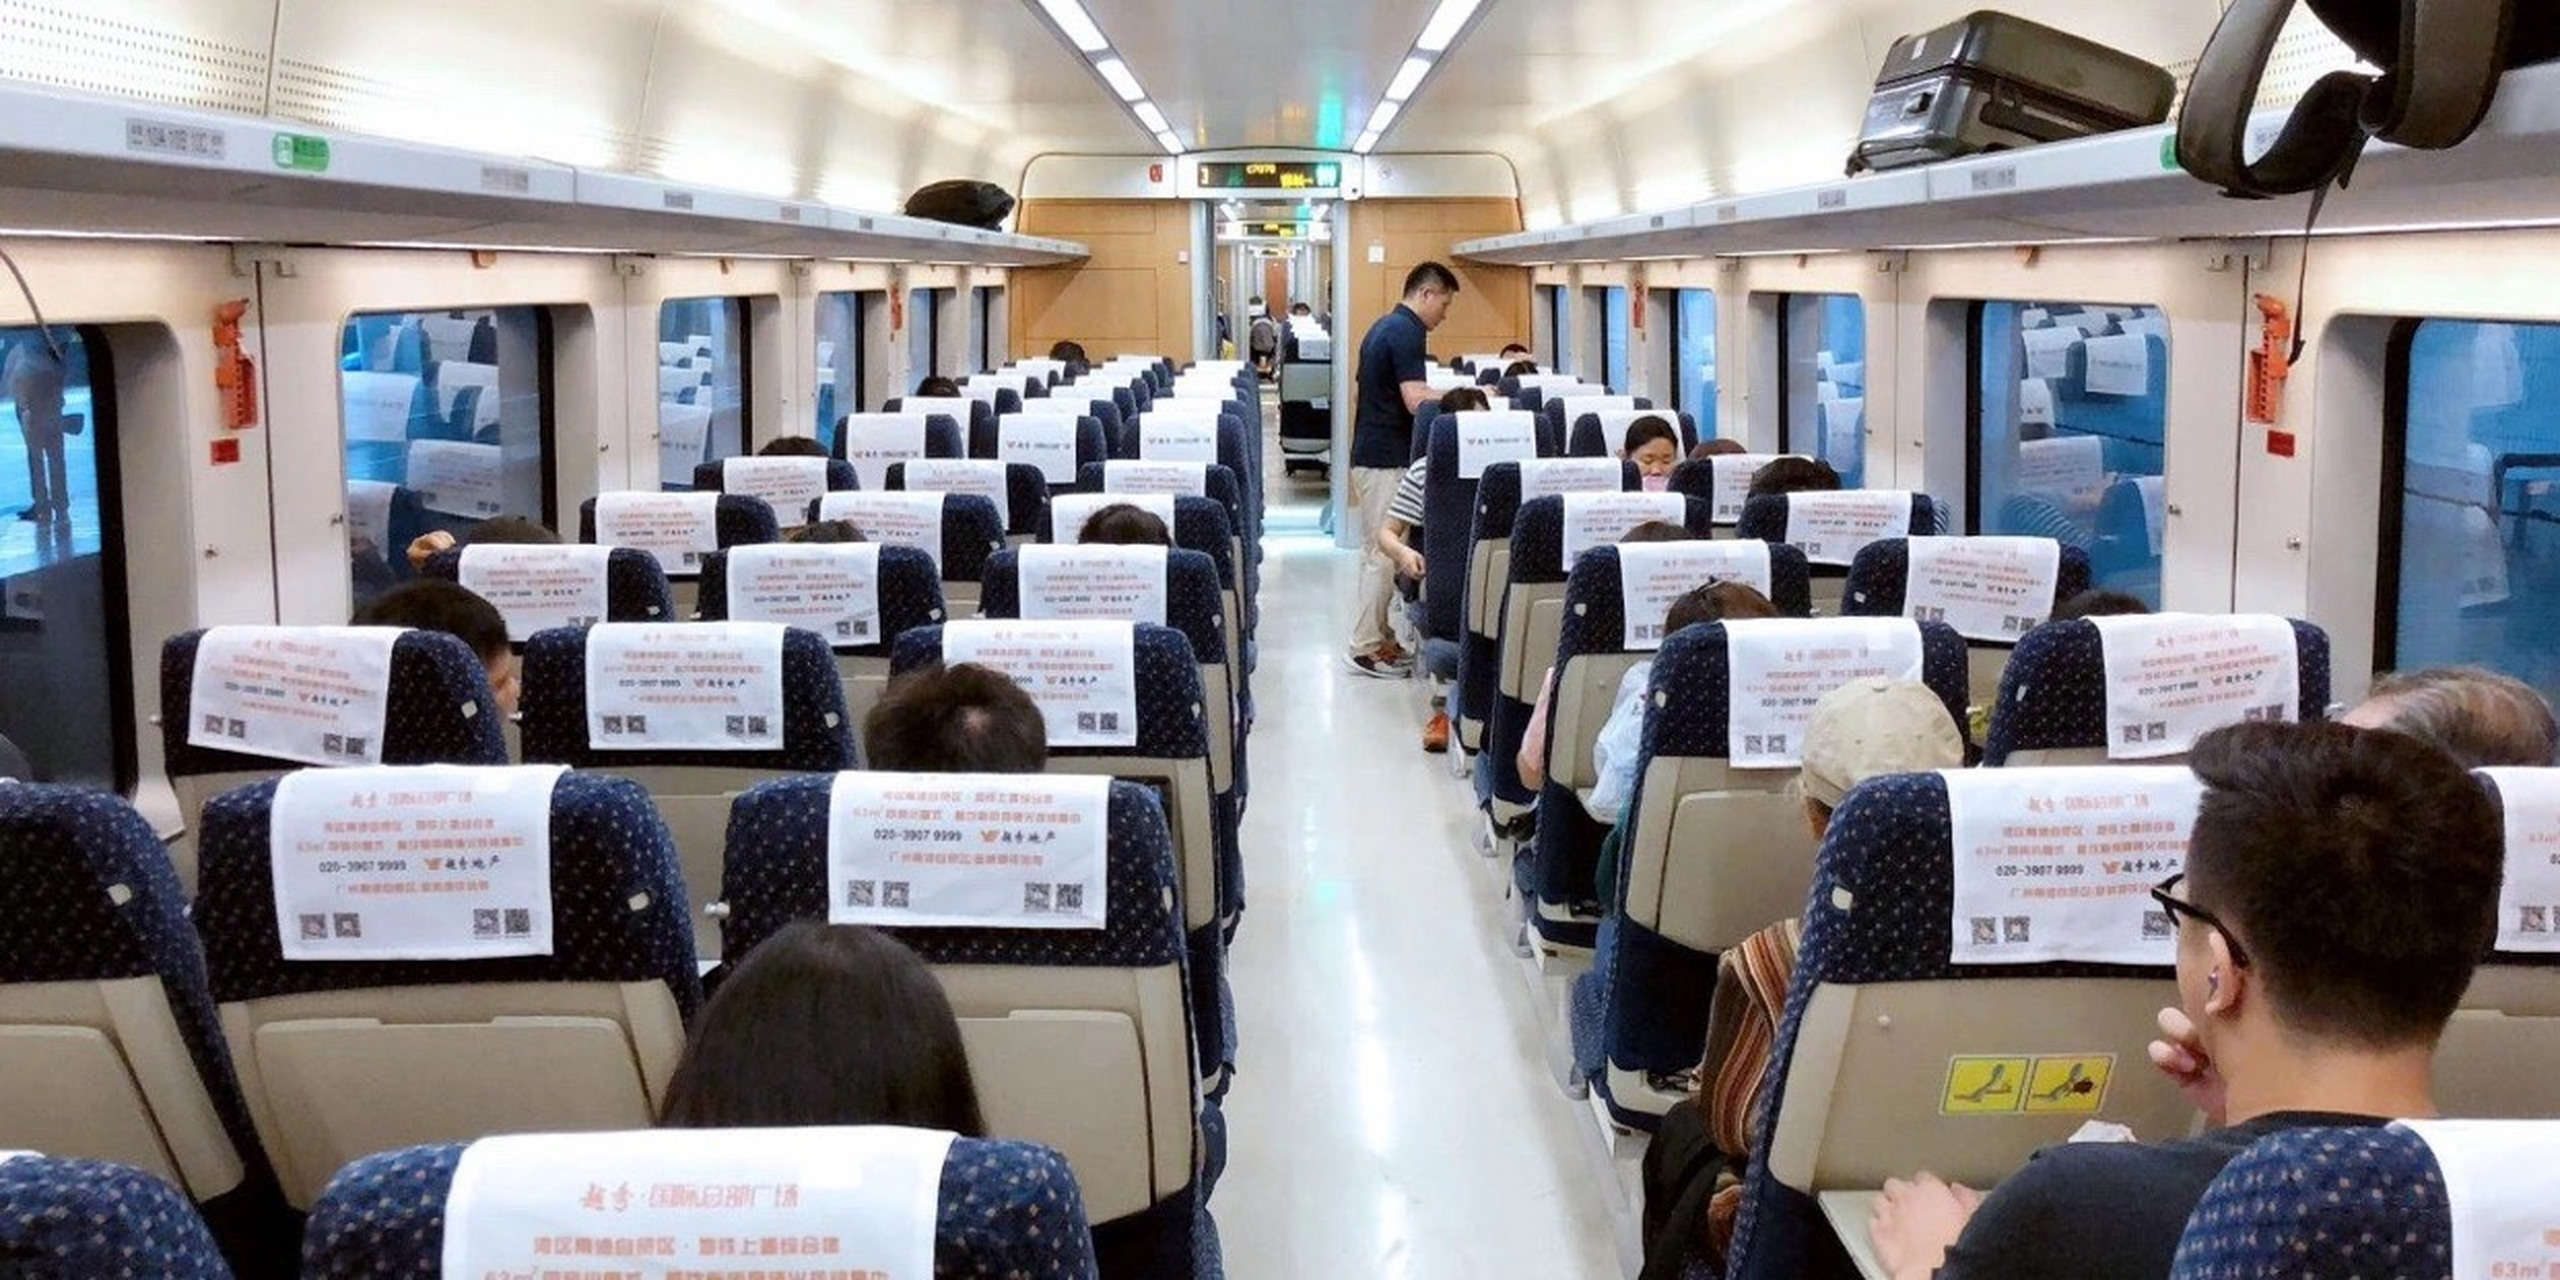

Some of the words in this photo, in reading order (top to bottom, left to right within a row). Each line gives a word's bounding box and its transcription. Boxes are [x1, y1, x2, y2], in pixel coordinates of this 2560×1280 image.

[874, 829, 931, 842] 020-3907
[933, 829, 963, 842] 9999
[1001, 830, 1057, 844] 越秀地产
[319, 860, 375, 873] 020-3907
[377, 859, 407, 872] 9999
[1995, 864, 2053, 877] 020-3907
[2055, 863, 2085, 876] 9999
